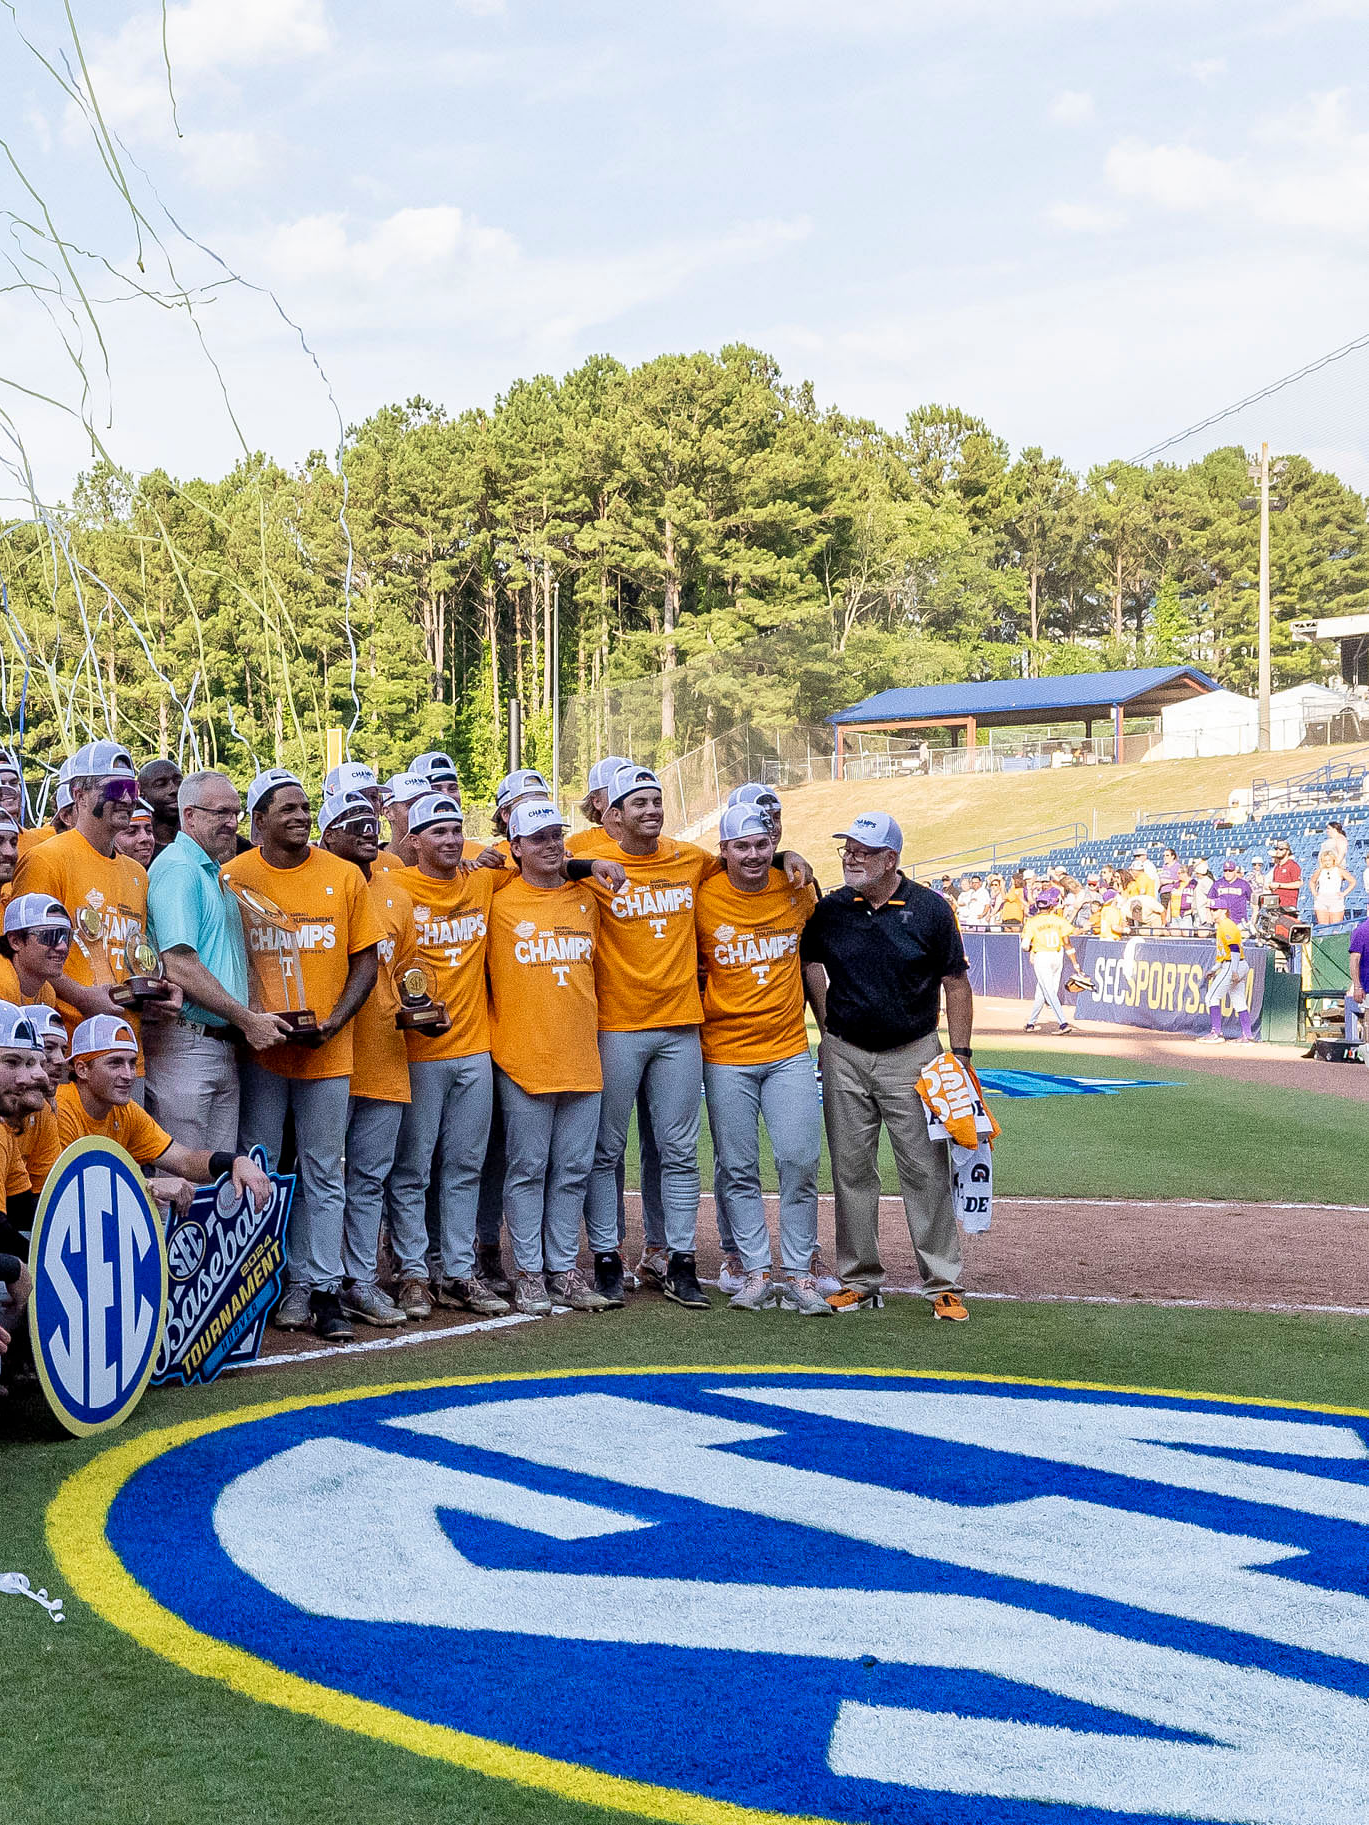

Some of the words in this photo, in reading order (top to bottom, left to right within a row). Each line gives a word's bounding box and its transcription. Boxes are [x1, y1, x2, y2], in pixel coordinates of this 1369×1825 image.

[611, 887, 693, 918] CHAMPS
[250, 924, 336, 951] CHAMPS
[649, 918, 667, 939] T
[445, 948, 462, 967] T
[515, 937, 593, 964] CHAMPS
[714, 934, 798, 965] CHAMPS
[552, 966, 570, 987] T
[751, 965, 769, 985] T
[168, 1226, 203, 1277] SEC
[240, 1234, 273, 1277] 2024
[44, 1165, 154, 1408] SEC
[182, 1240, 281, 1376] TOURNAMENT
[221, 1302, 258, 1353] HOOVER
